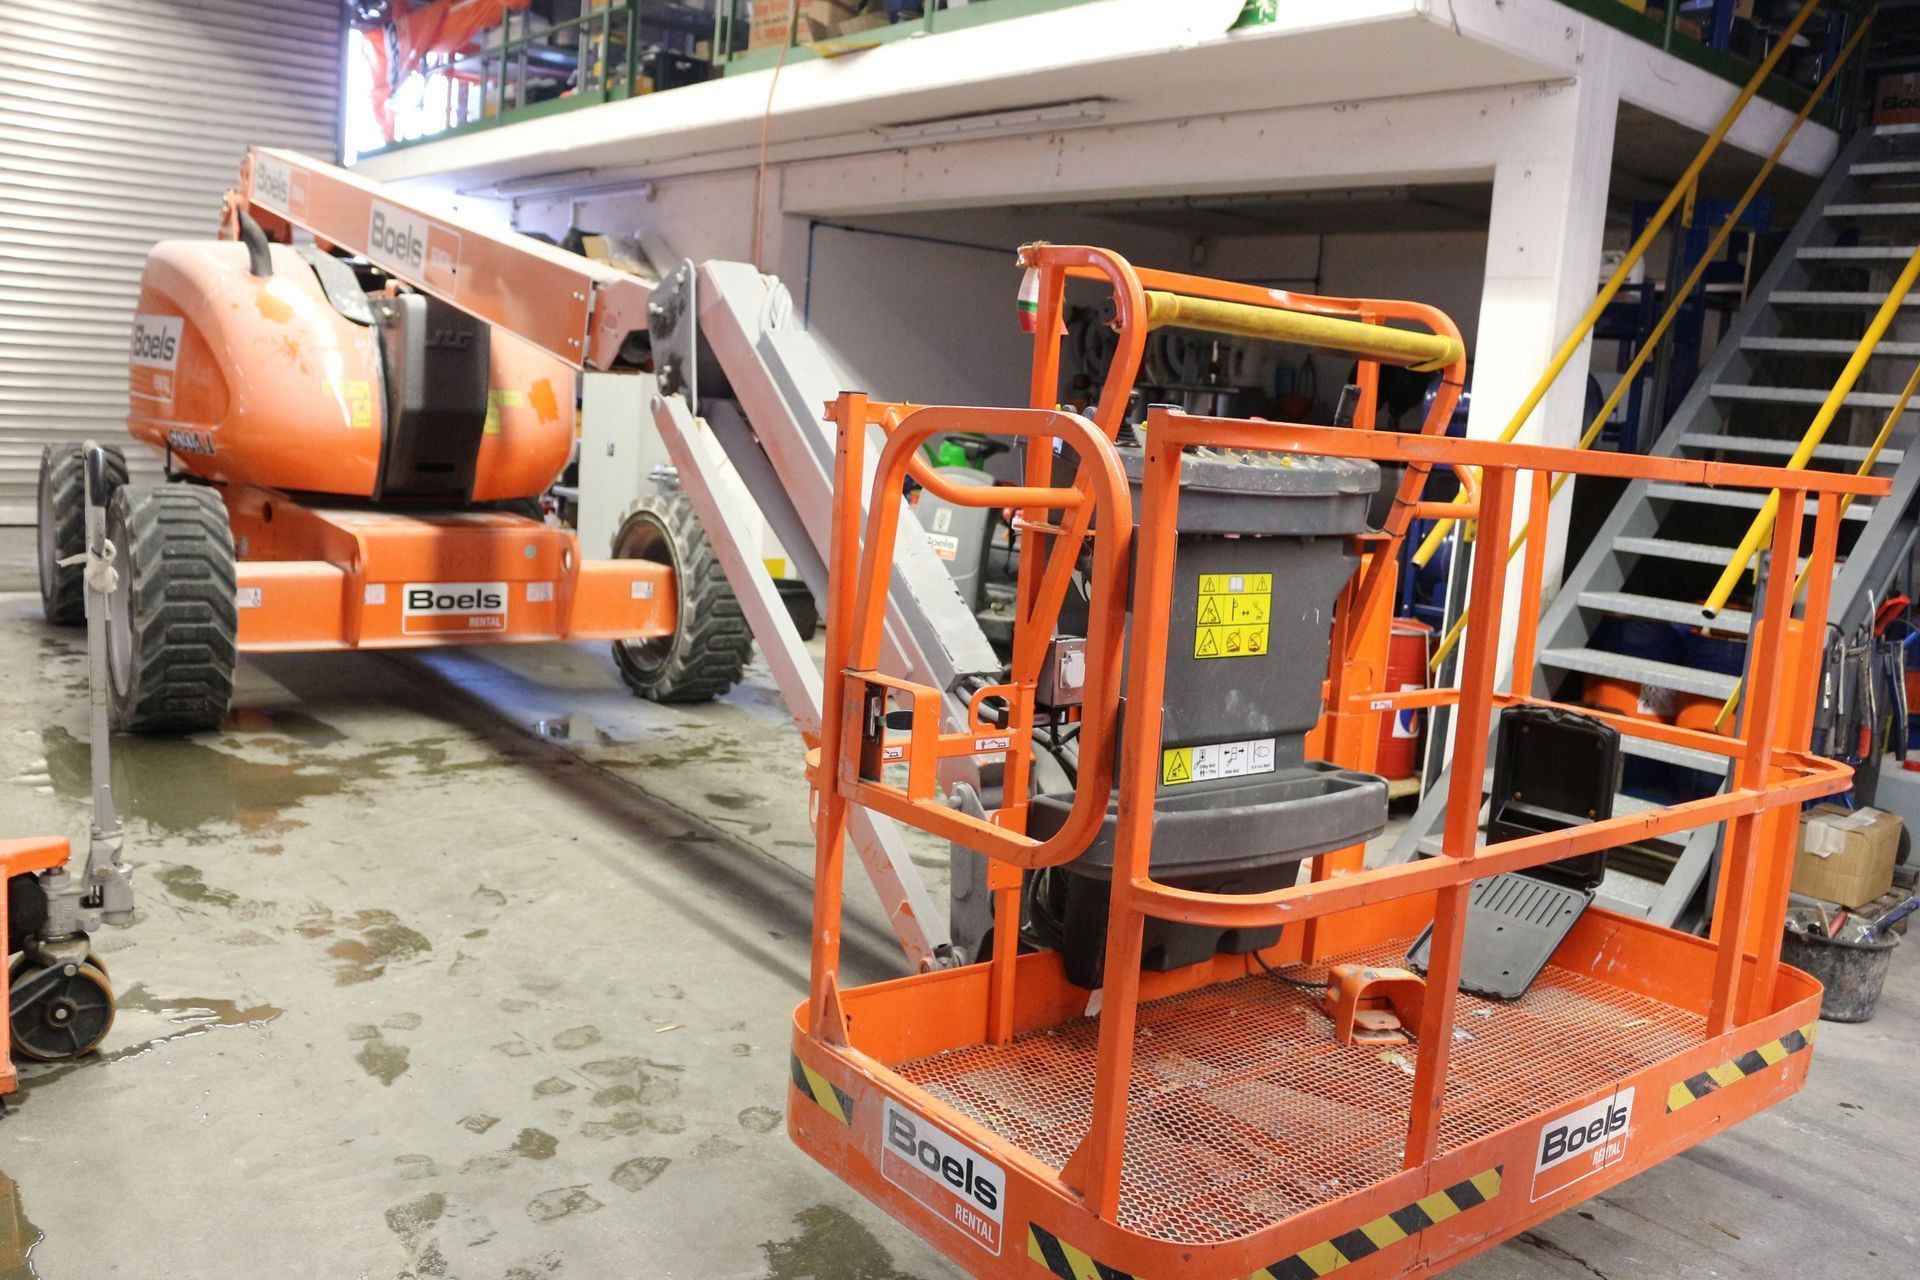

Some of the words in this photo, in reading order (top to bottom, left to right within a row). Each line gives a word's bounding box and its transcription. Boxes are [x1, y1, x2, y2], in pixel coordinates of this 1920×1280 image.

[256, 166, 288, 202] Boels
[370, 209, 423, 268] Boels
[134, 323, 176, 361] Boels
[409, 588, 502, 610] Boels
[469, 616, 501, 628] RENTAL
[1541, 1104, 1627, 1166] Boels
[1592, 1141, 1621, 1166] RENTAL
[888, 1108, 998, 1211] Boels
[954, 1202, 995, 1245] RENTAL
